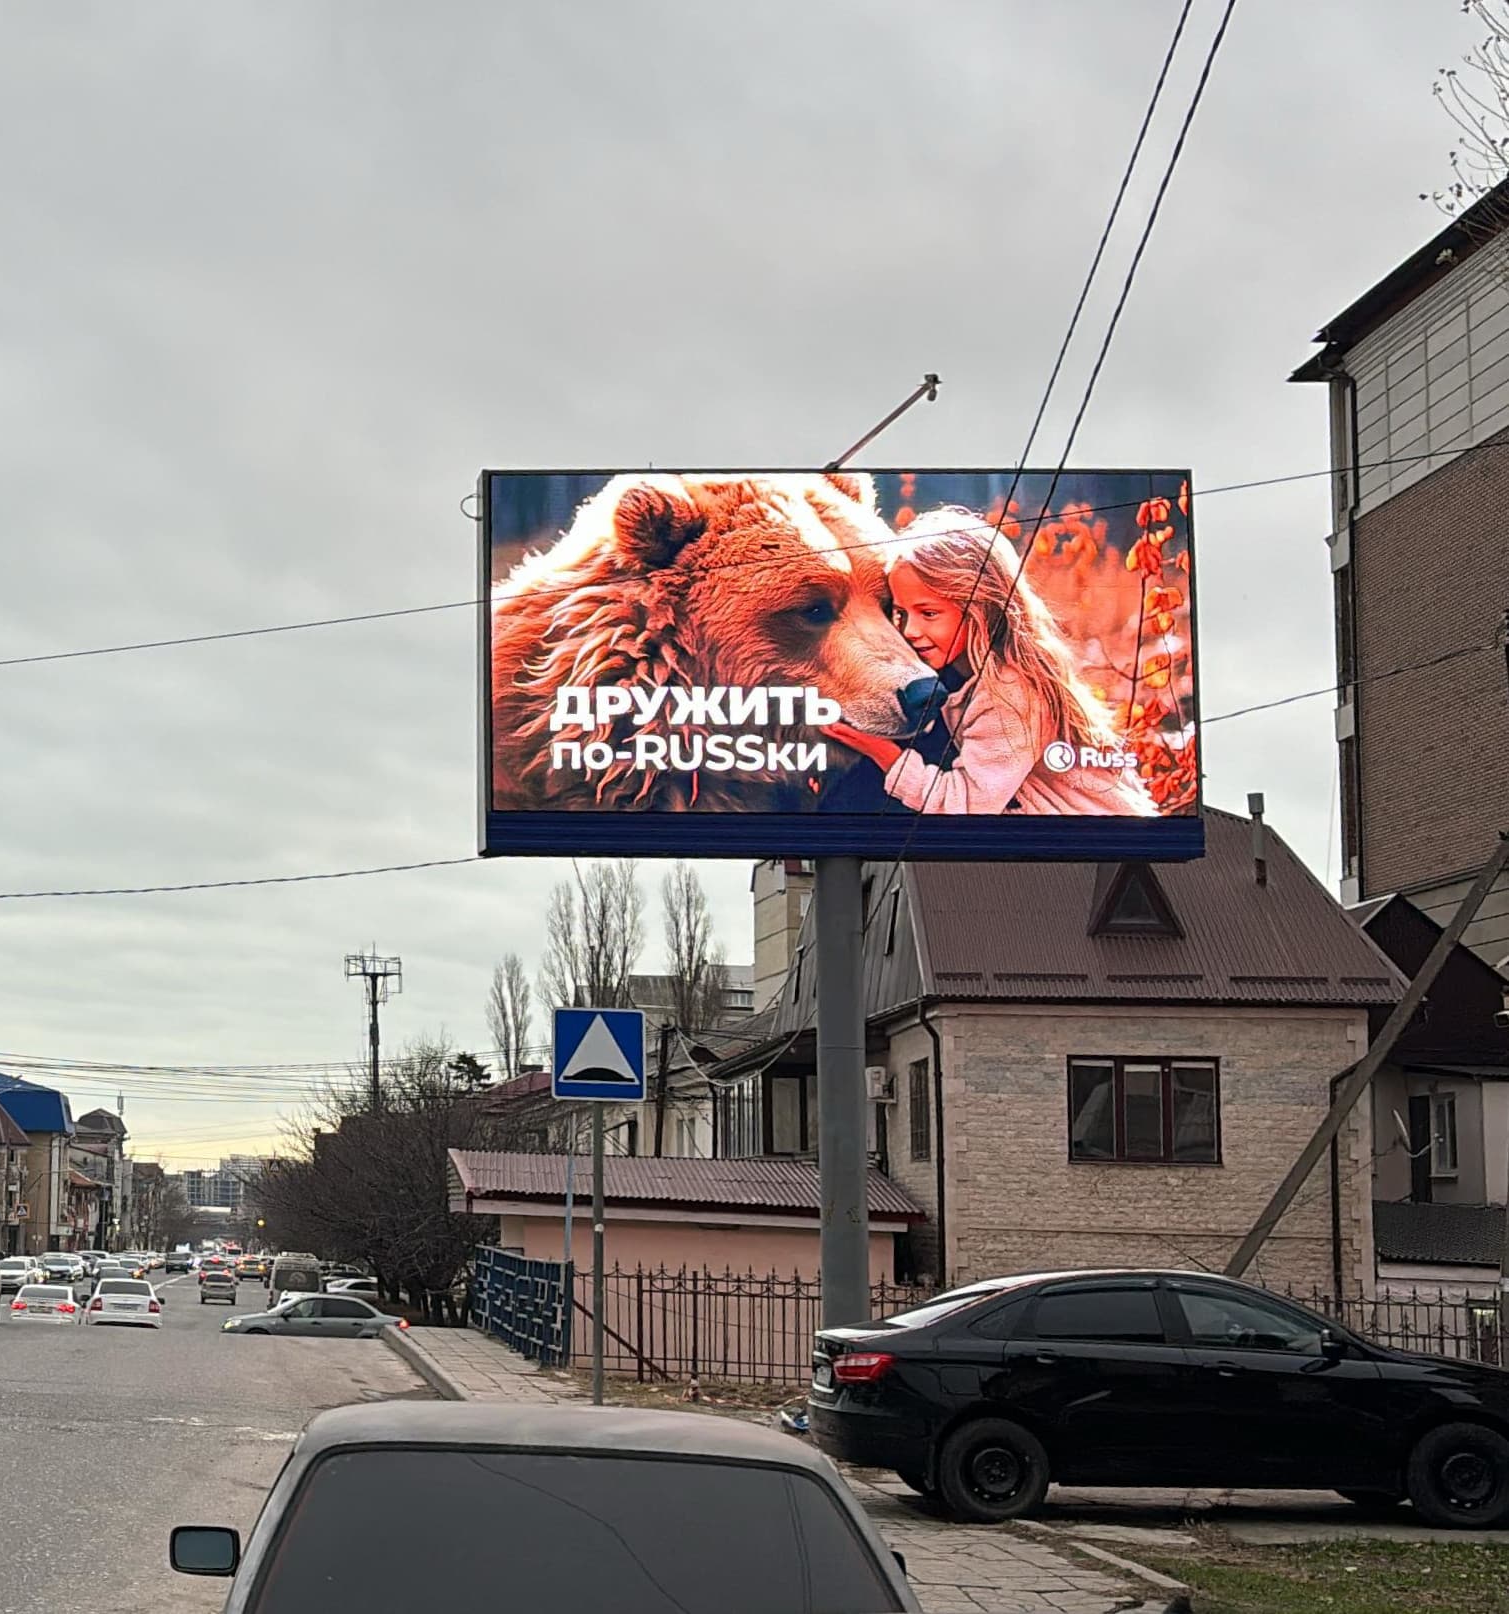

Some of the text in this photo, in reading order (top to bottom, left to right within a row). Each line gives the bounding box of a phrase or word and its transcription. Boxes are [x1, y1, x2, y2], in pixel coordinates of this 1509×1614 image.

[550, 686, 842, 731] ДРУЖИТЬ
[553, 734, 827, 772] по-RUSSки
[1080, 747, 1138, 768] Russ
